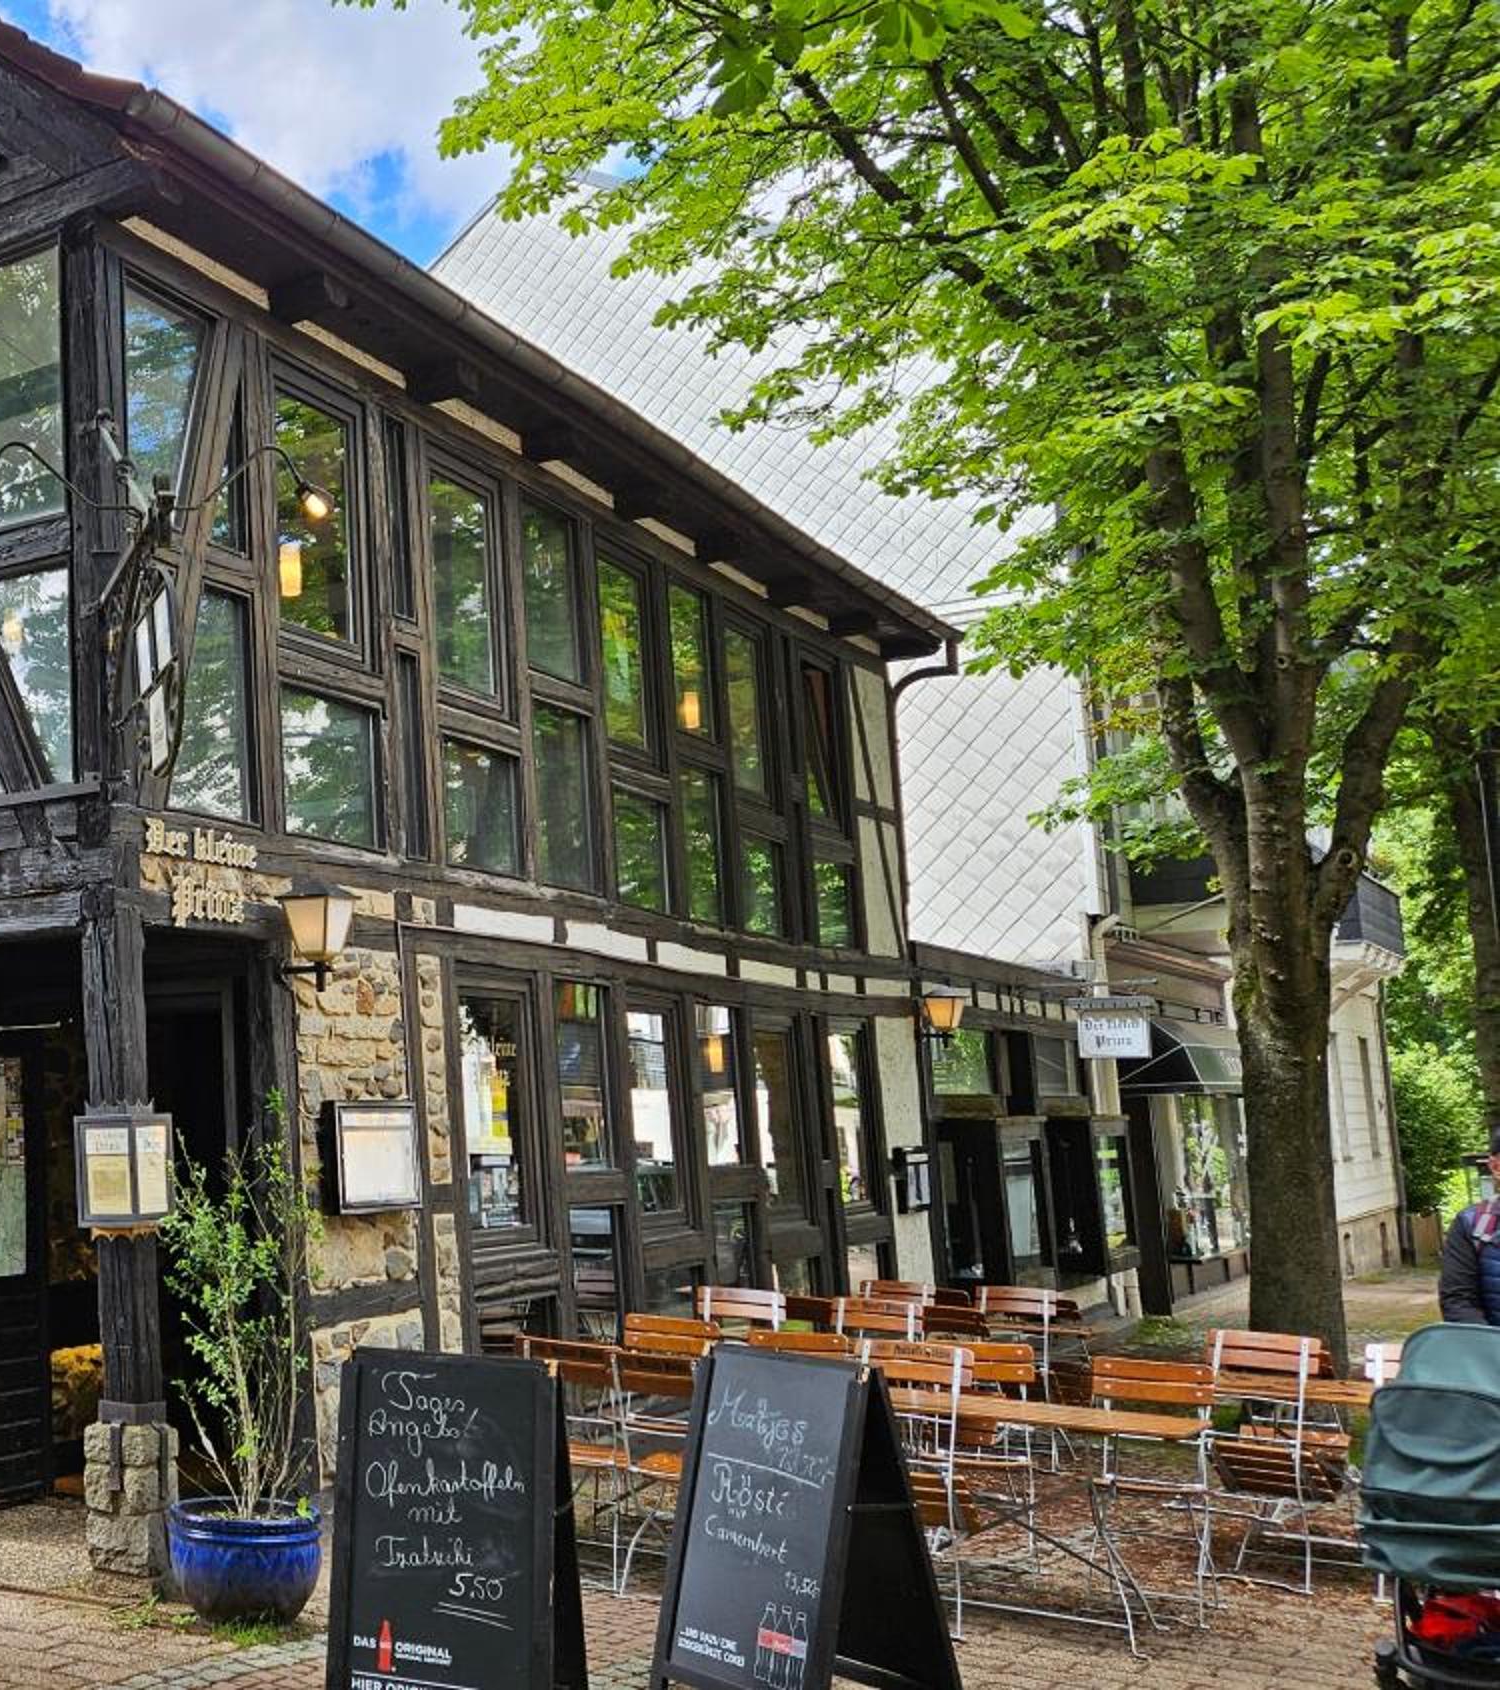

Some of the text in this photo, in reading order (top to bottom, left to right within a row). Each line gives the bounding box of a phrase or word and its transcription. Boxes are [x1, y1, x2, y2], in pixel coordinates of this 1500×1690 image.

[145, 816, 258, 869] Der kleine
[172, 876, 245, 928] Prinz
[1094, 1034, 1132, 1049] Prinz
[381, 1371, 465, 1424] Tages
[366, 1457, 525, 1508] Ofenkartoffeln
[711, 1461, 789, 1516] Rösti
[407, 1497, 463, 1524] mit
[704, 1514, 788, 1565] Camembert
[353, 1635, 377, 1649] DAS
[394, 1641, 452, 1660] ORIGINAL
